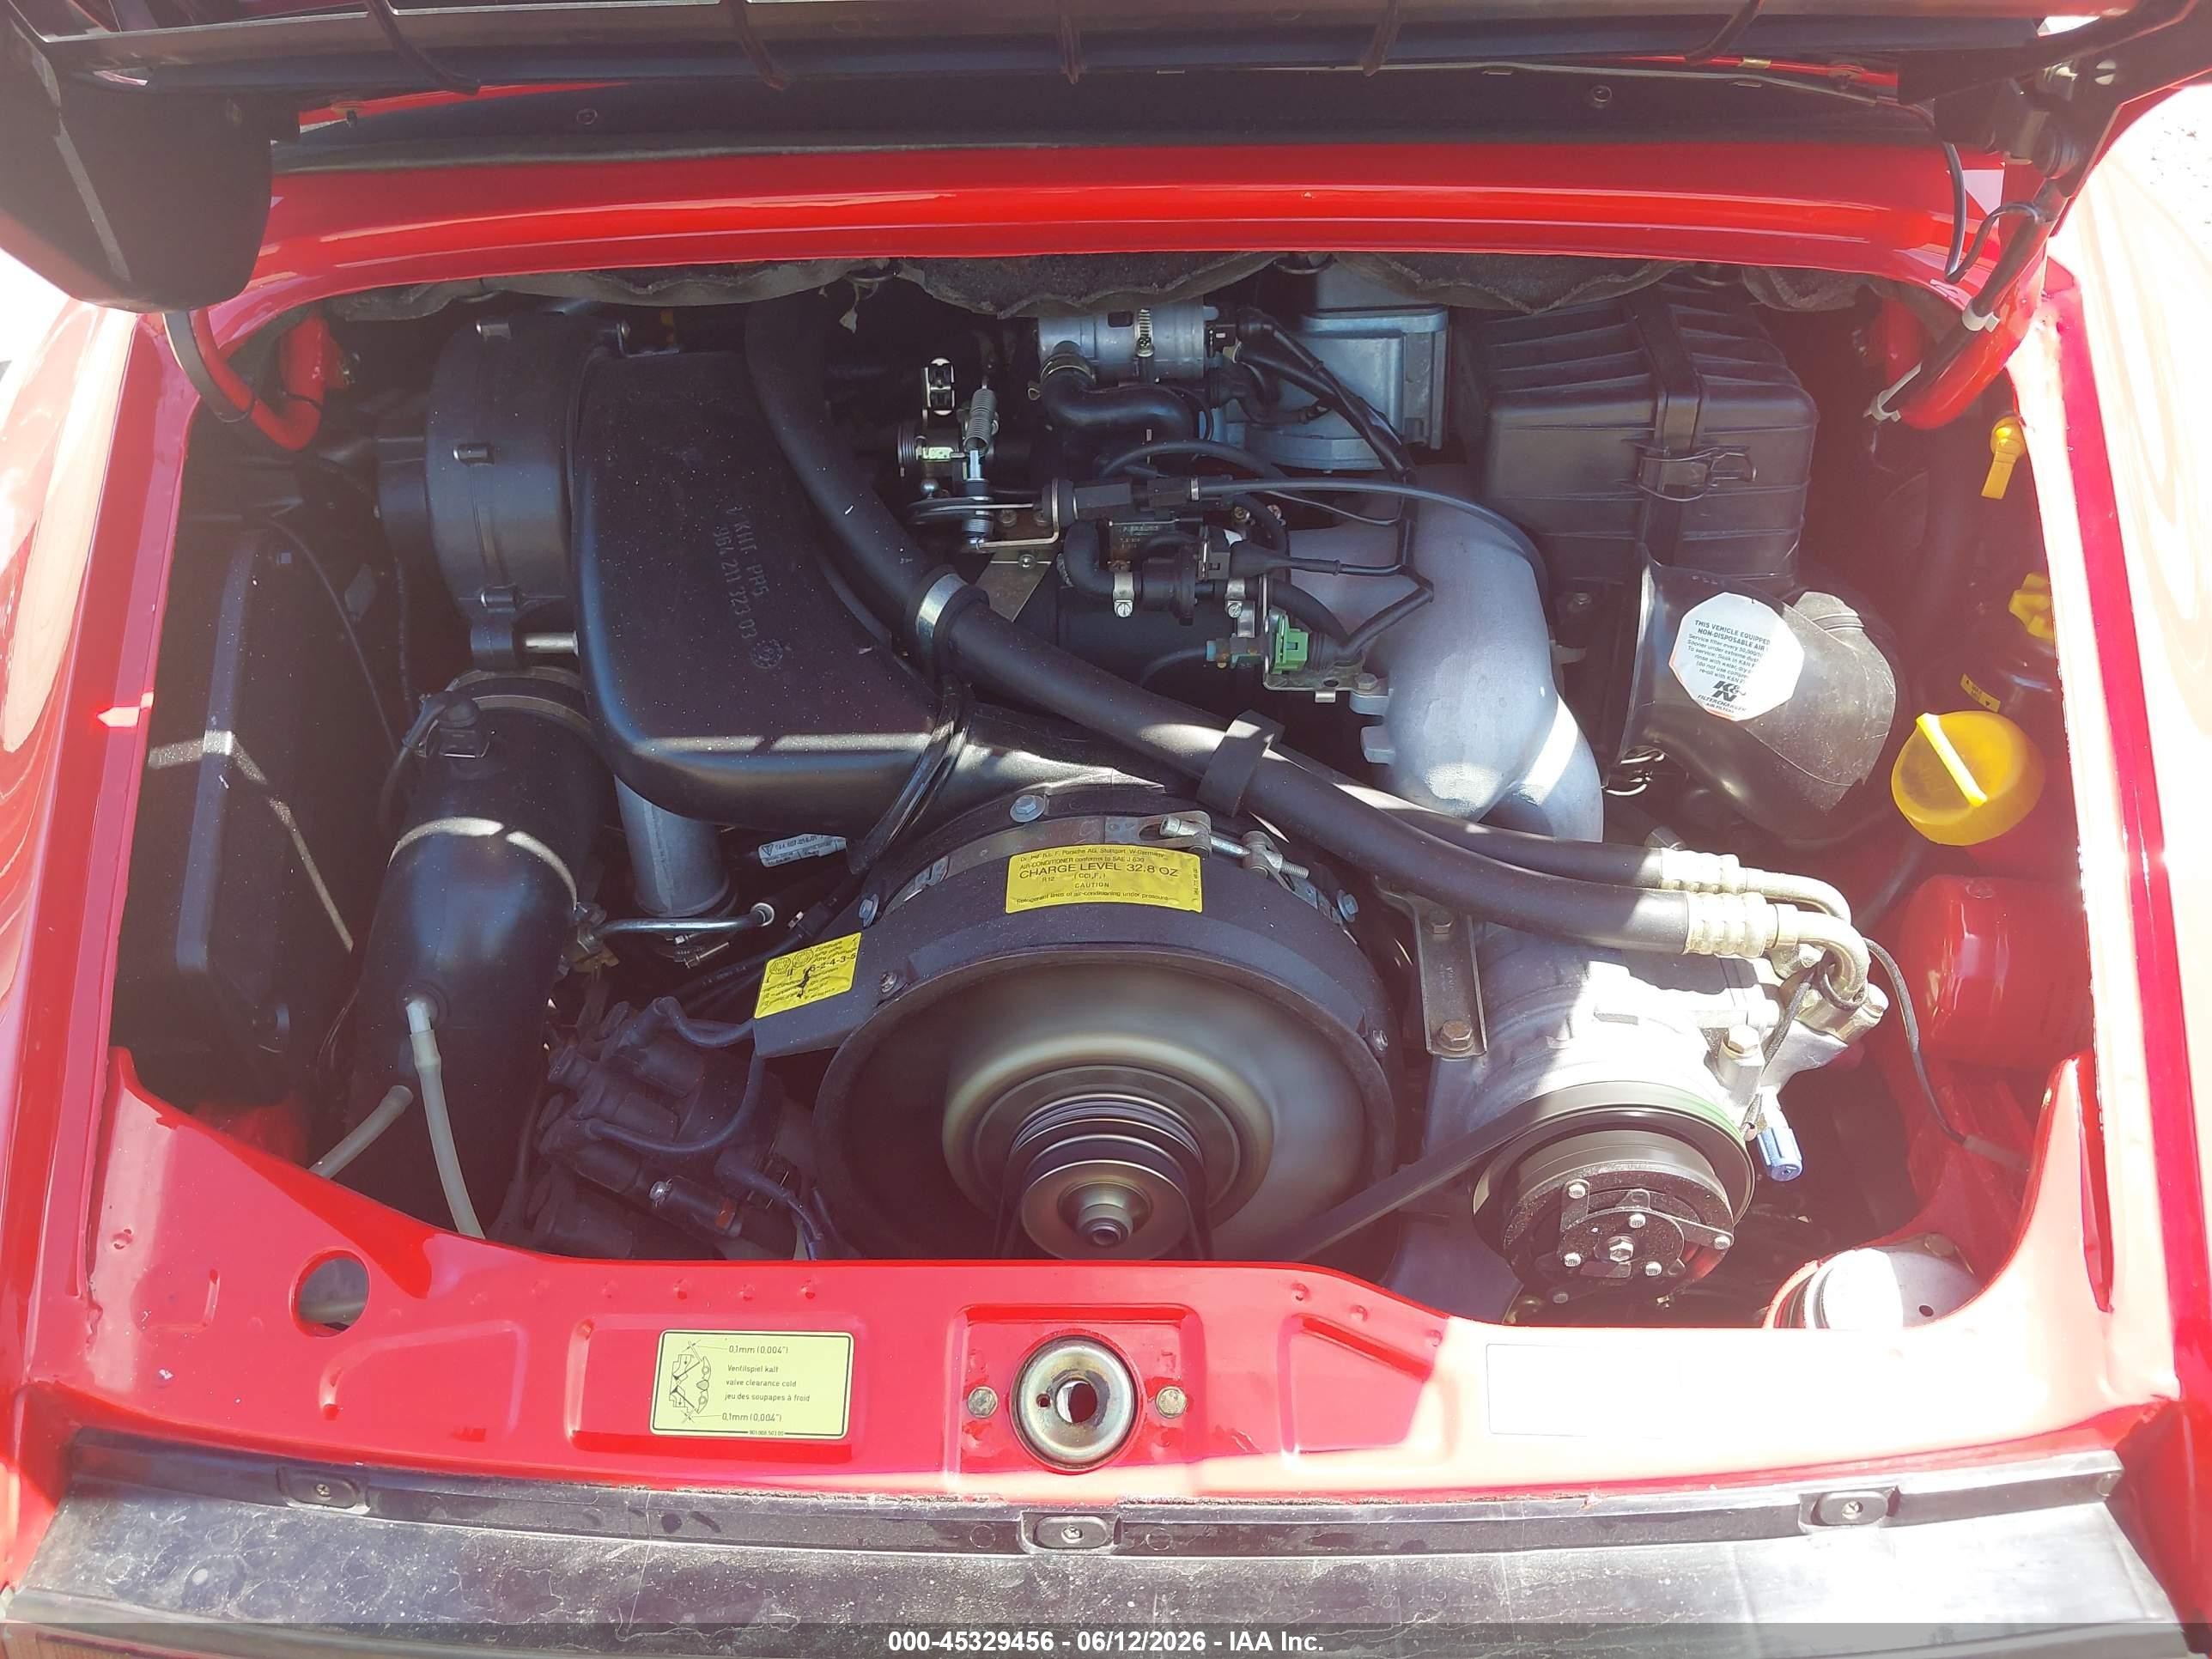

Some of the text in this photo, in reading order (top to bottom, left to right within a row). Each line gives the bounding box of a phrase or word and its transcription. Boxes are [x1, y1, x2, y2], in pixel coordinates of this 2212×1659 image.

[720, 559, 743, 584] 211
[729, 586, 751, 616] 323
[738, 618, 757, 640] 03
[1694, 619, 1771, 646] THIS VEHICLE EQUIPPED
[1688, 634, 1710, 643] Service
[1723, 642, 1739, 651] every
[1698, 628, 1753, 648] NON-DISPOSABLE
[1687, 639, 1707, 648] Sooner
[1707, 643, 1724, 652] under
[1724, 648, 1747, 659] extreme
[1694, 653, 1709, 662] rinse
[1738, 665, 1747, 674] dry
[1717, 653, 1732, 662] Soak
[1738, 659, 1752, 668] K&N
[1019, 858, 1073, 870] AIR-CONDITIONER
[1019, 864, 1077, 879] CHARGE
[1080, 862, 1121, 871] LEVEL
[1159, 866, 1180, 877] OZ
[1141, 892, 1169, 901] pressure
[727, 1364, 779, 1374] Ventilspiel kalt
[745, 1379, 781, 1388] clearance
[724, 1393, 736, 1401] jeu
[750, 1394, 786, 1403] soupapes
[793, 1394, 811, 1402] froid
